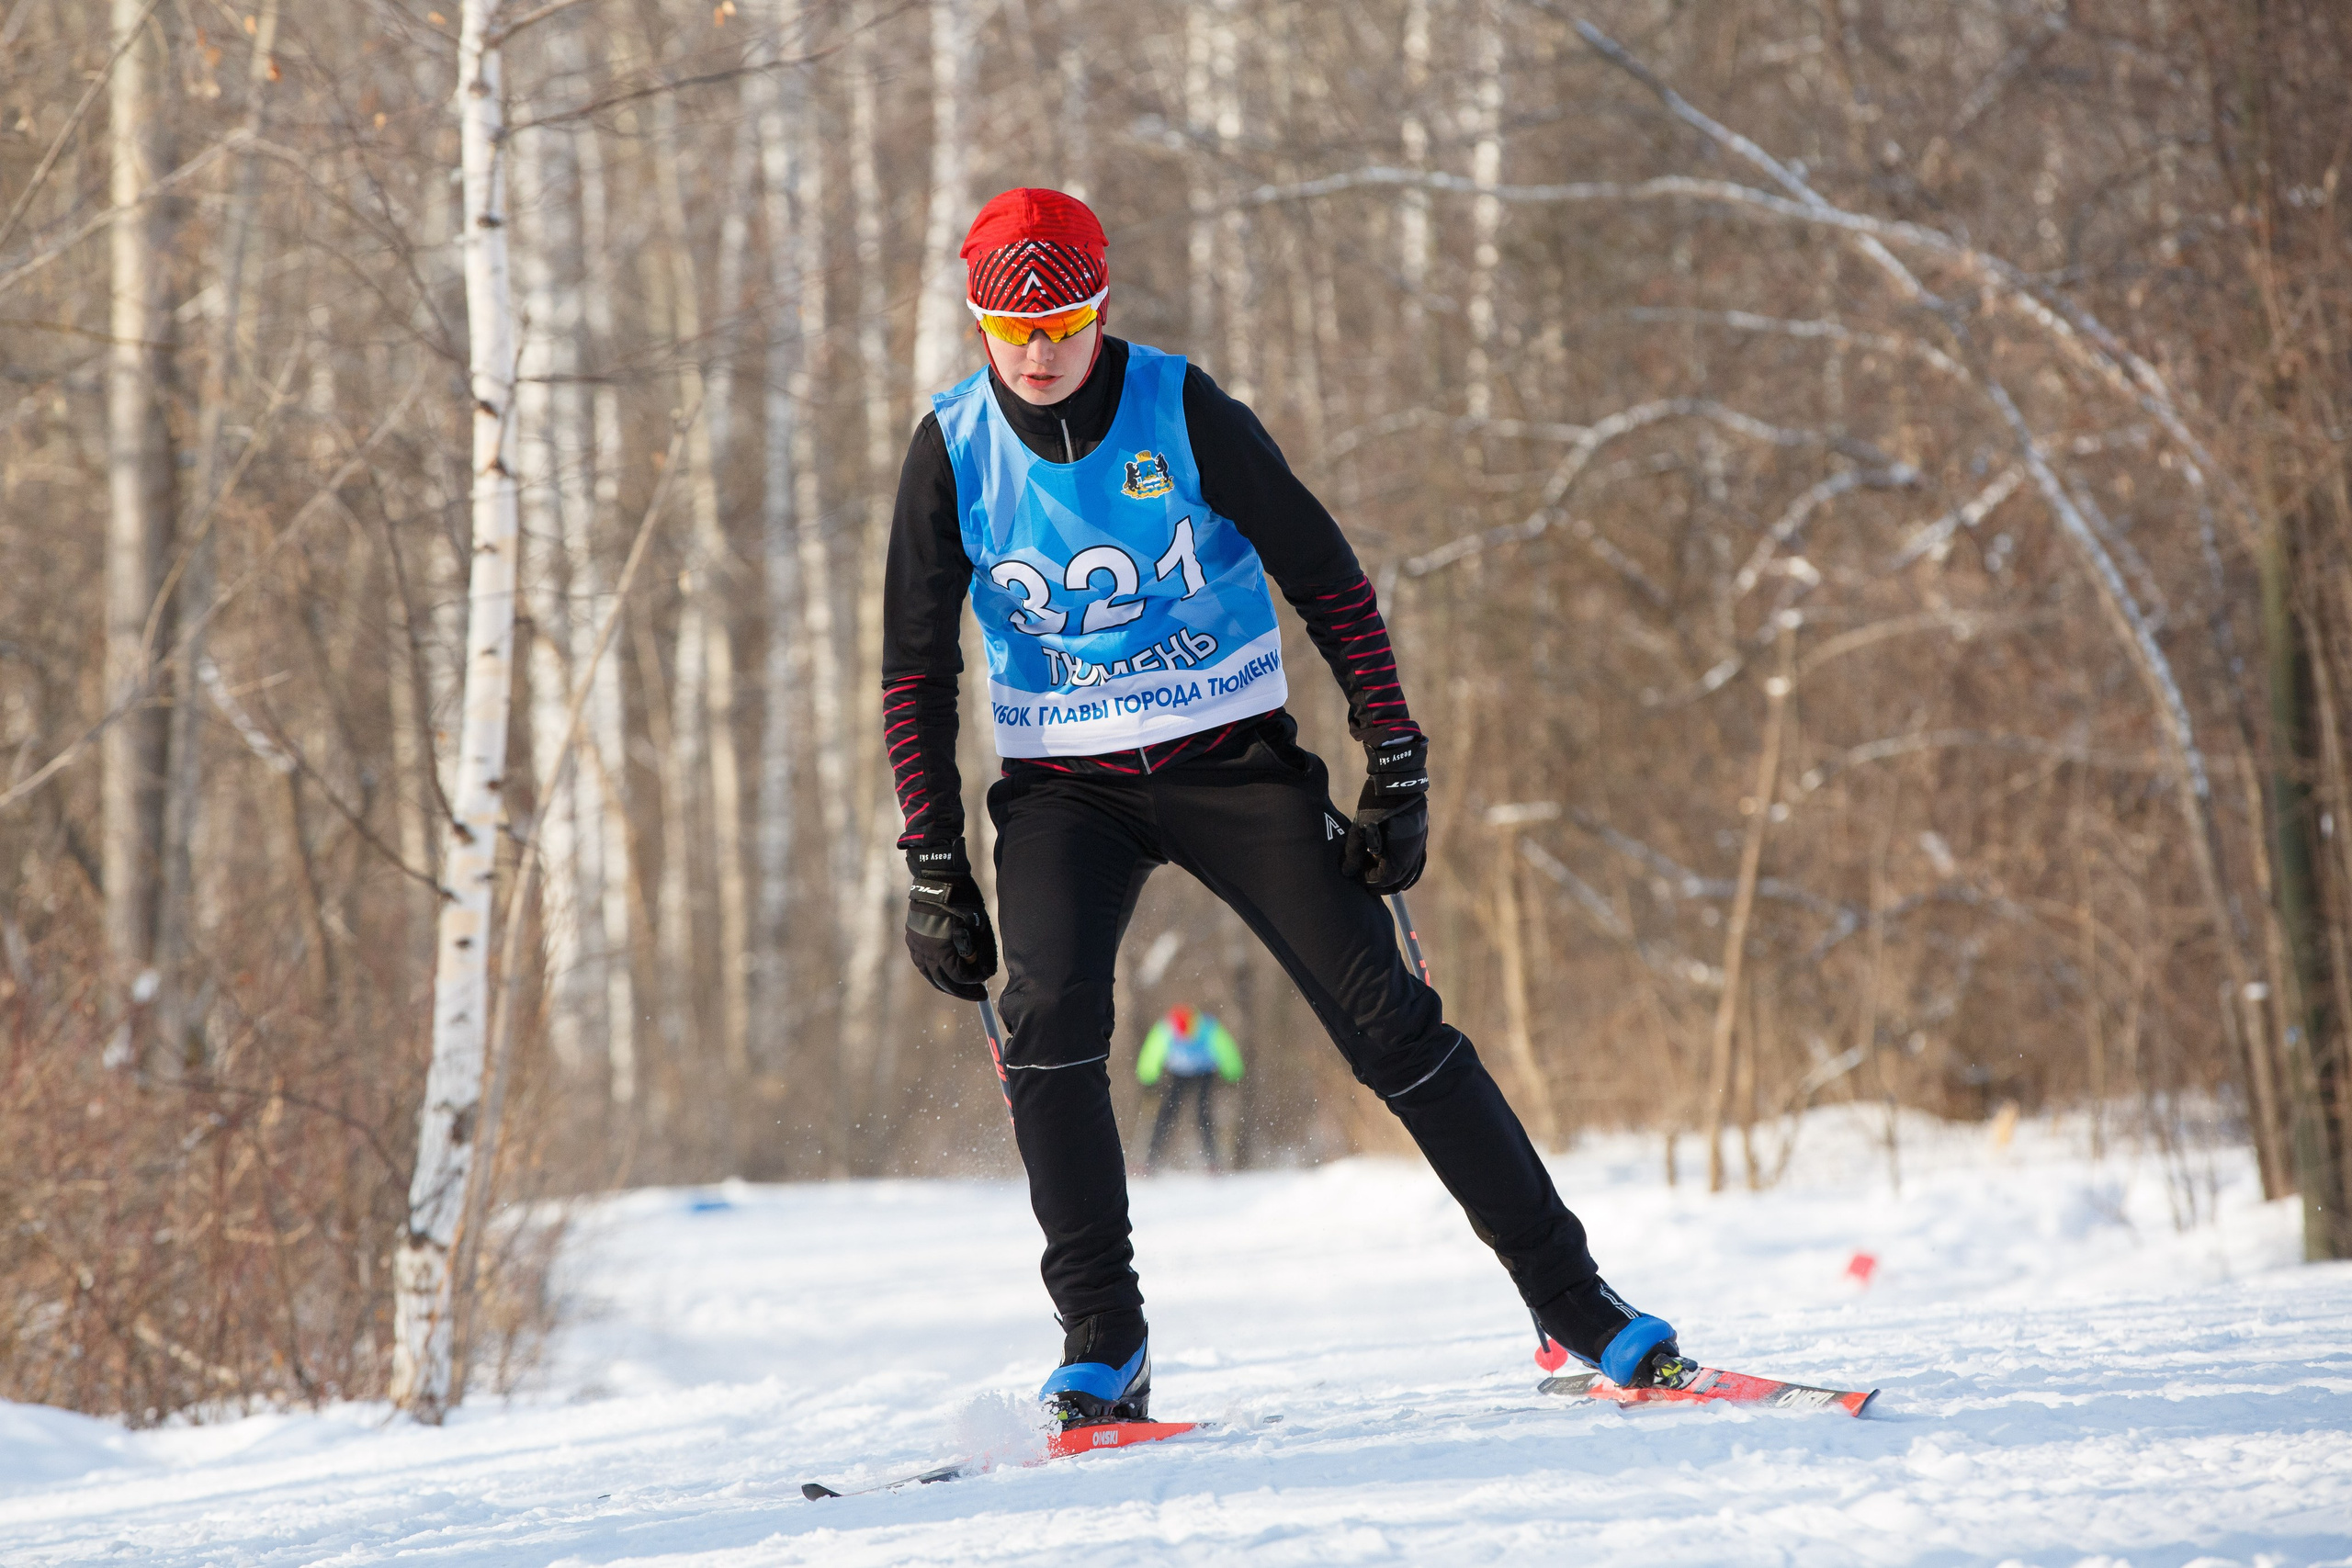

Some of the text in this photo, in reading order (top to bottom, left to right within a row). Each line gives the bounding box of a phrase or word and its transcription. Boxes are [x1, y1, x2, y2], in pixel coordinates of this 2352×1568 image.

[989, 515, 1207, 636] 321
[991, 649, 1281, 727] УБОК ГЛАВЫ ГОРОДА ТЮМЕНИ
[1379, 757, 1390, 765] ski
[919, 852, 952, 863] #easy ski
[910, 885, 944, 896] PILO
[1091, 1430, 1119, 1447] ONSKI
